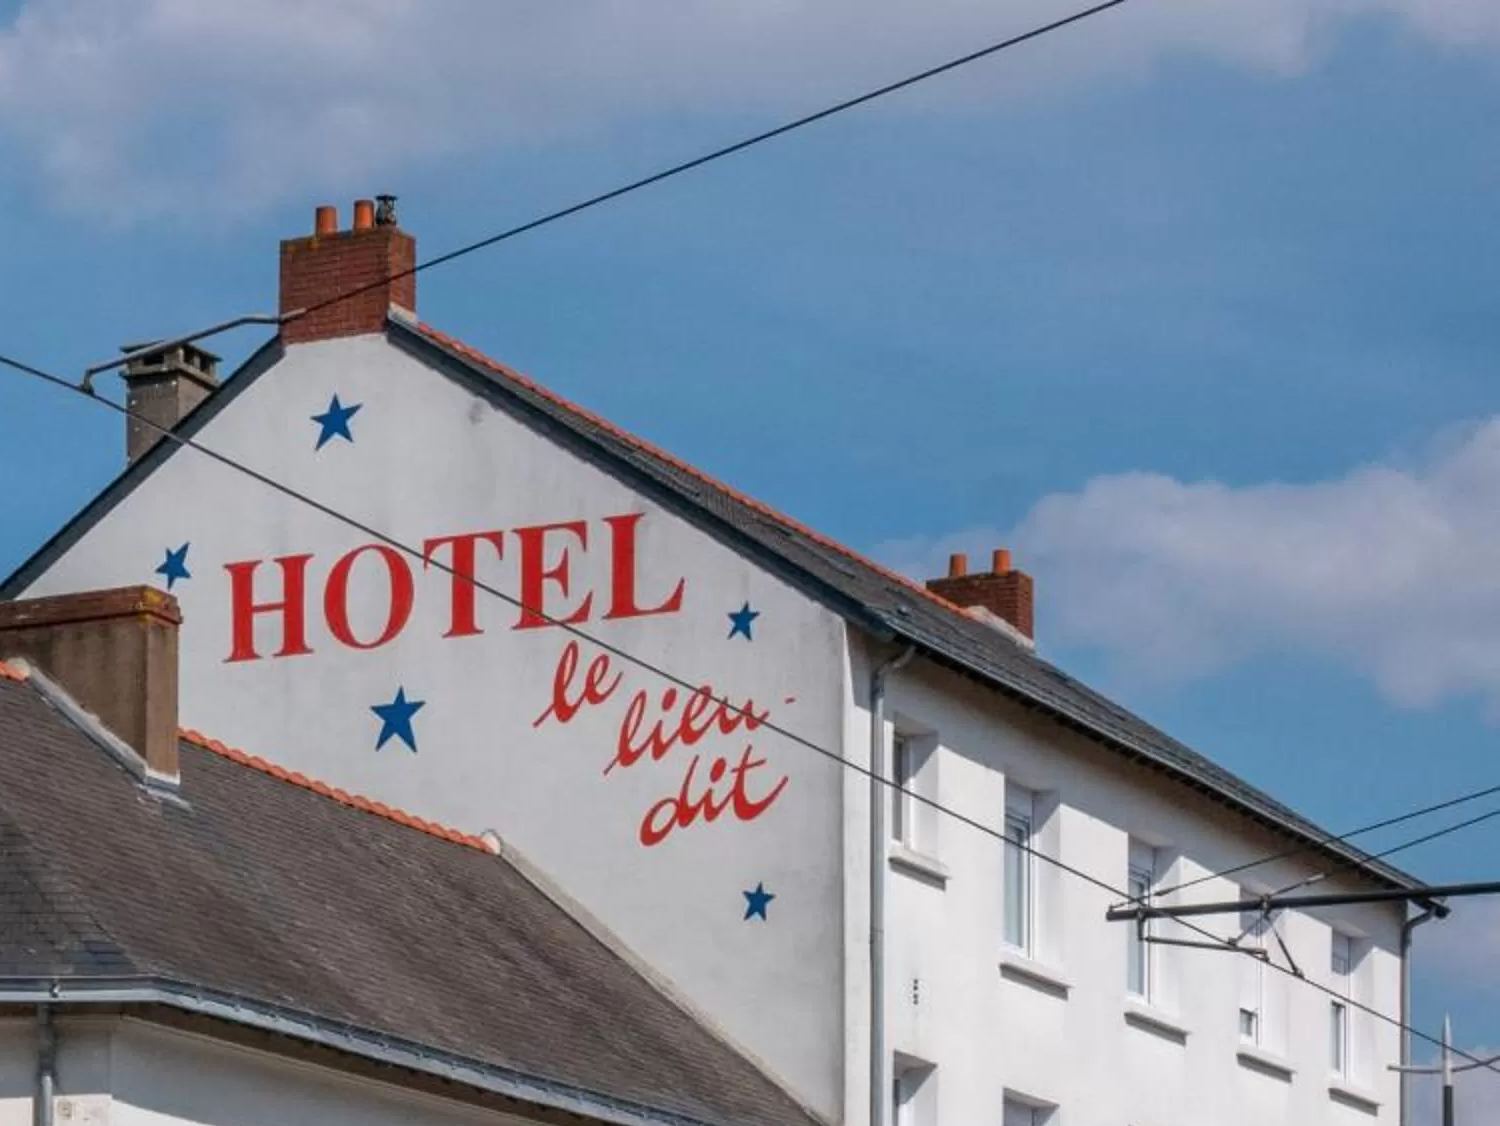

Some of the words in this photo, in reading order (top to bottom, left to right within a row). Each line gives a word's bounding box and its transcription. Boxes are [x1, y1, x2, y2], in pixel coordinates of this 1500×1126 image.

[223, 513, 686, 663] HOTEL
[534, 641, 623, 728] le
[640, 745, 788, 847] dit
